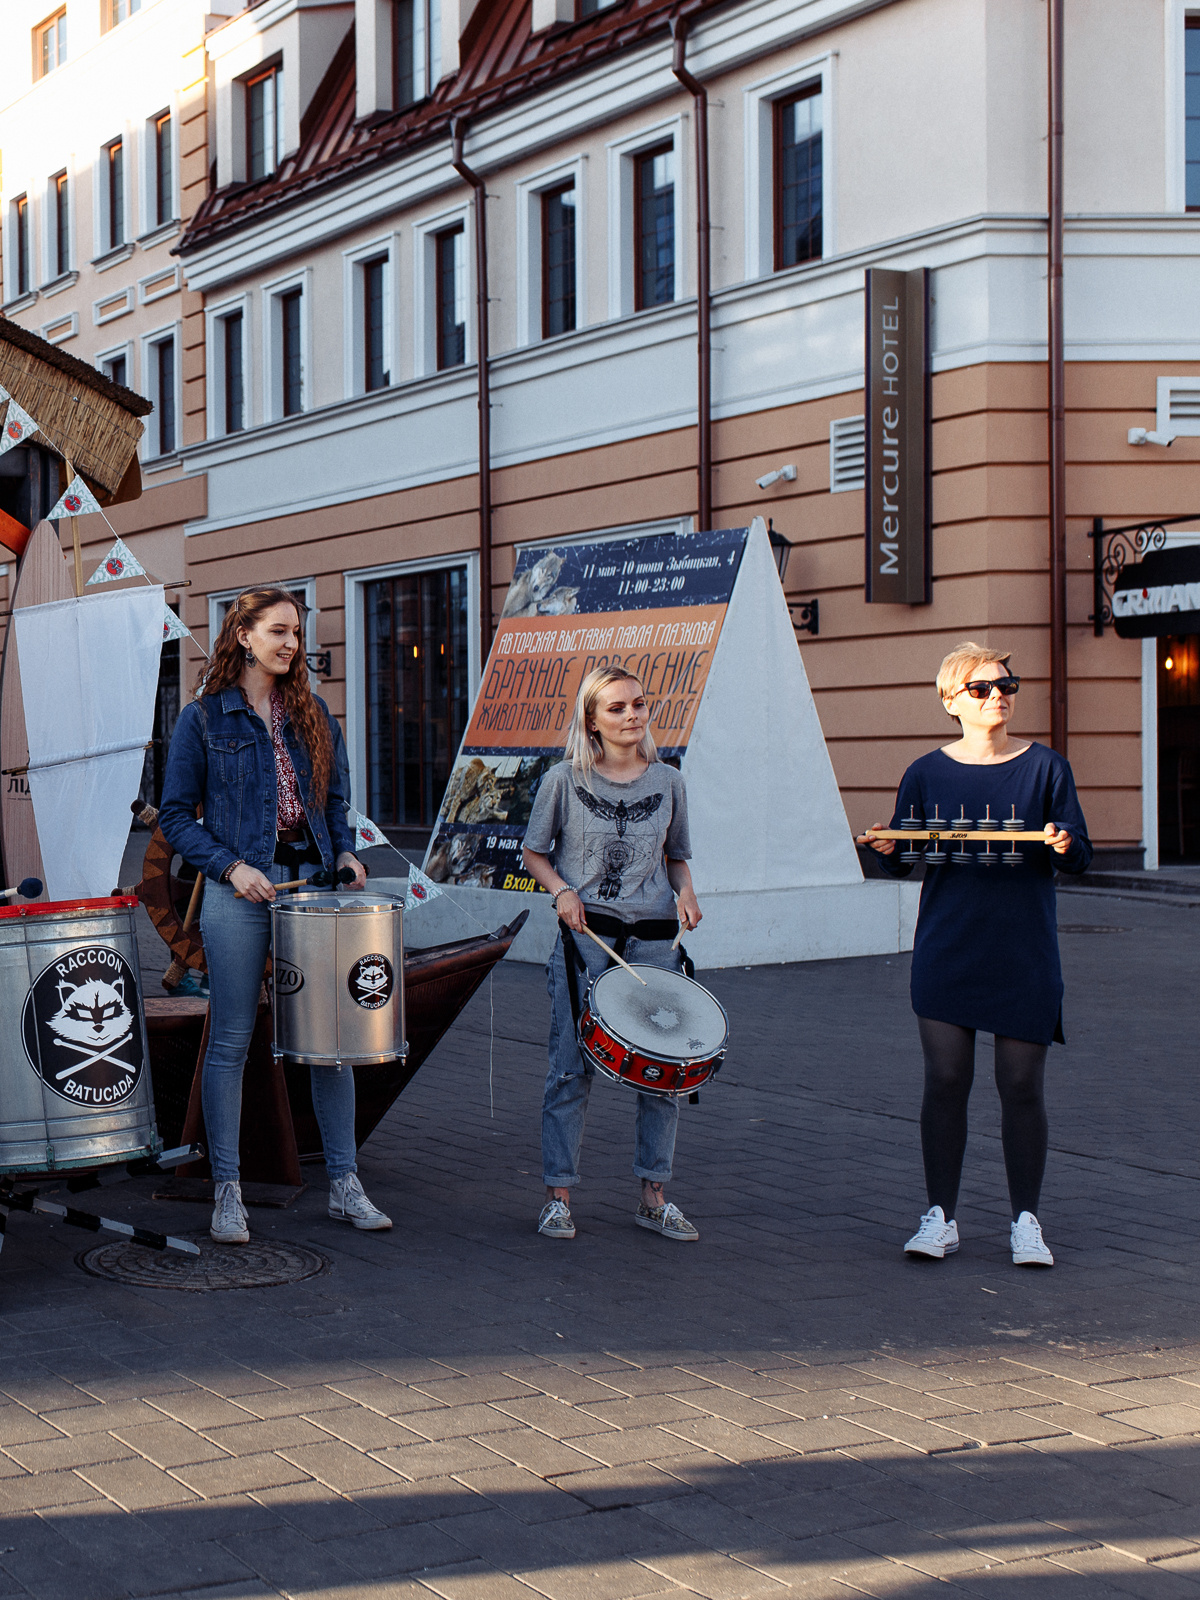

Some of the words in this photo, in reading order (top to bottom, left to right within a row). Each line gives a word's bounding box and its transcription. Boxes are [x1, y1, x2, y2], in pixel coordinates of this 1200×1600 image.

[882, 295, 899, 396] HOTEL
[880, 405, 900, 575] Mercure
[583, 563, 596, 579] 11
[635, 561, 664, 574] июня
[665, 554, 722, 571] Зыбицкая,
[727, 550, 736, 566] 4
[617, 575, 686, 596] 11:00-23:00
[497, 630, 558, 655] АВТОРСКАЯ
[555, 626, 615, 652] ВЫСТАВКА
[612, 624, 653, 650] ПАВЛА
[652, 620, 717, 646] ГЛАЗКОВА
[484, 656, 578, 700] БРАЧНОЕ
[476, 701, 556, 731] ЖИВОТНЫХ
[554, 701, 567, 731] В
[486, 836, 497, 849] 19
[498, 839, 519, 850] мая
[502, 873, 537, 893] Вход
[55, 949, 123, 978] RACCOON
[359, 954, 385, 966] RACCOON
[360, 997, 387, 1009] BATUCADA
[62, 1073, 134, 1103] BATUCADA
